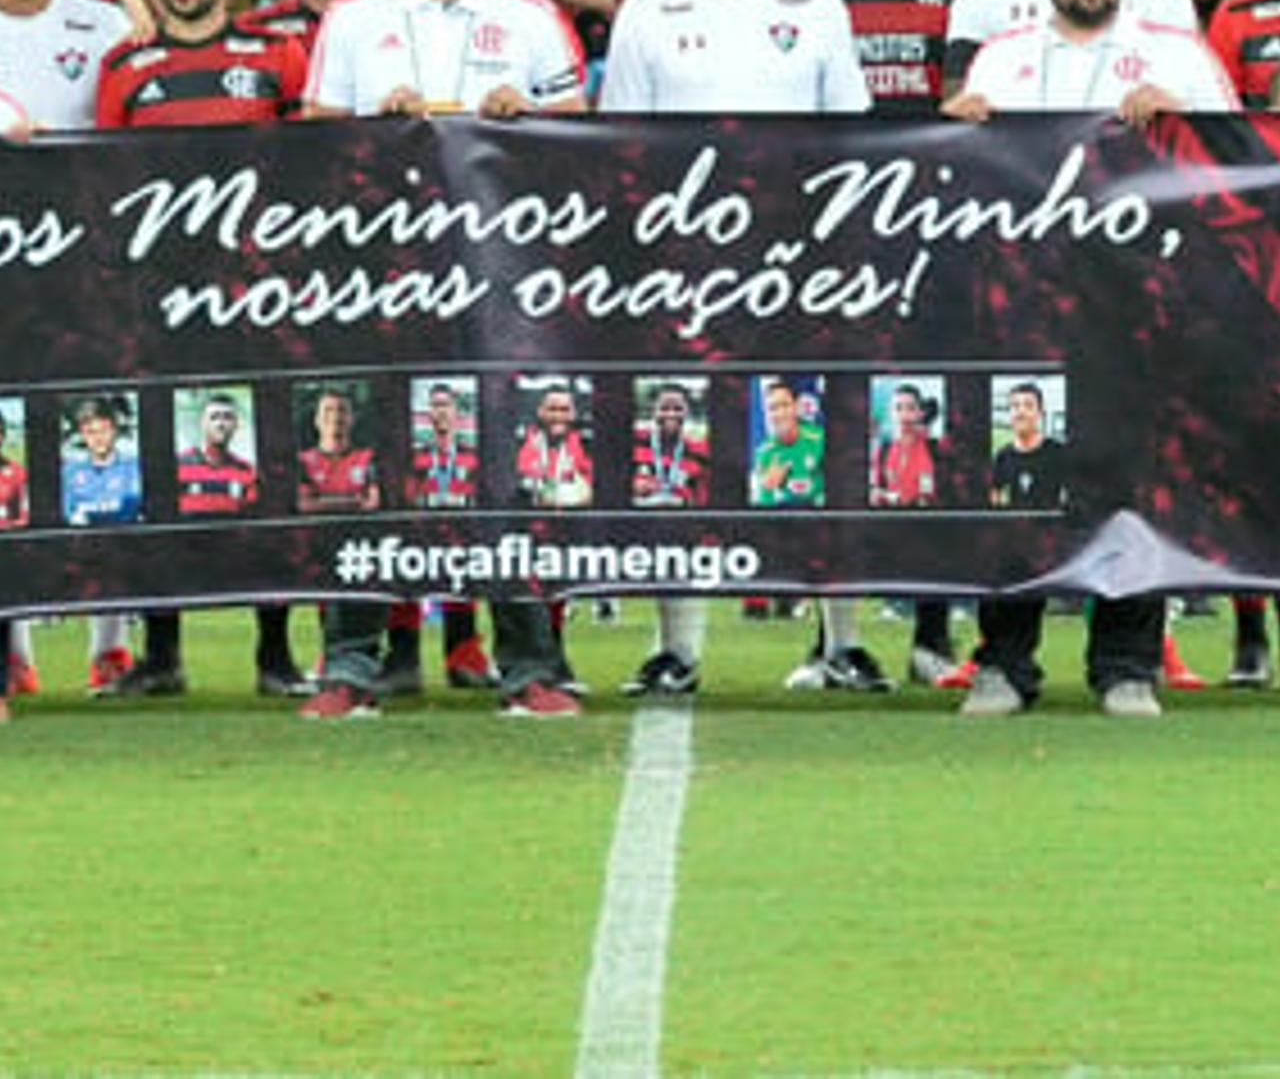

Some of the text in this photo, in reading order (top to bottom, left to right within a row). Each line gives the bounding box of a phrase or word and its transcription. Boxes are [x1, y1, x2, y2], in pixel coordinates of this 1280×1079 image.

[111, 168, 607, 259] Meninos
[636, 147, 751, 244] do
[804, 144, 1182, 258] Ninho,
[160, 245, 930, 339] nossas orações!
[336, 534, 760, 592] #forçaflamengo
